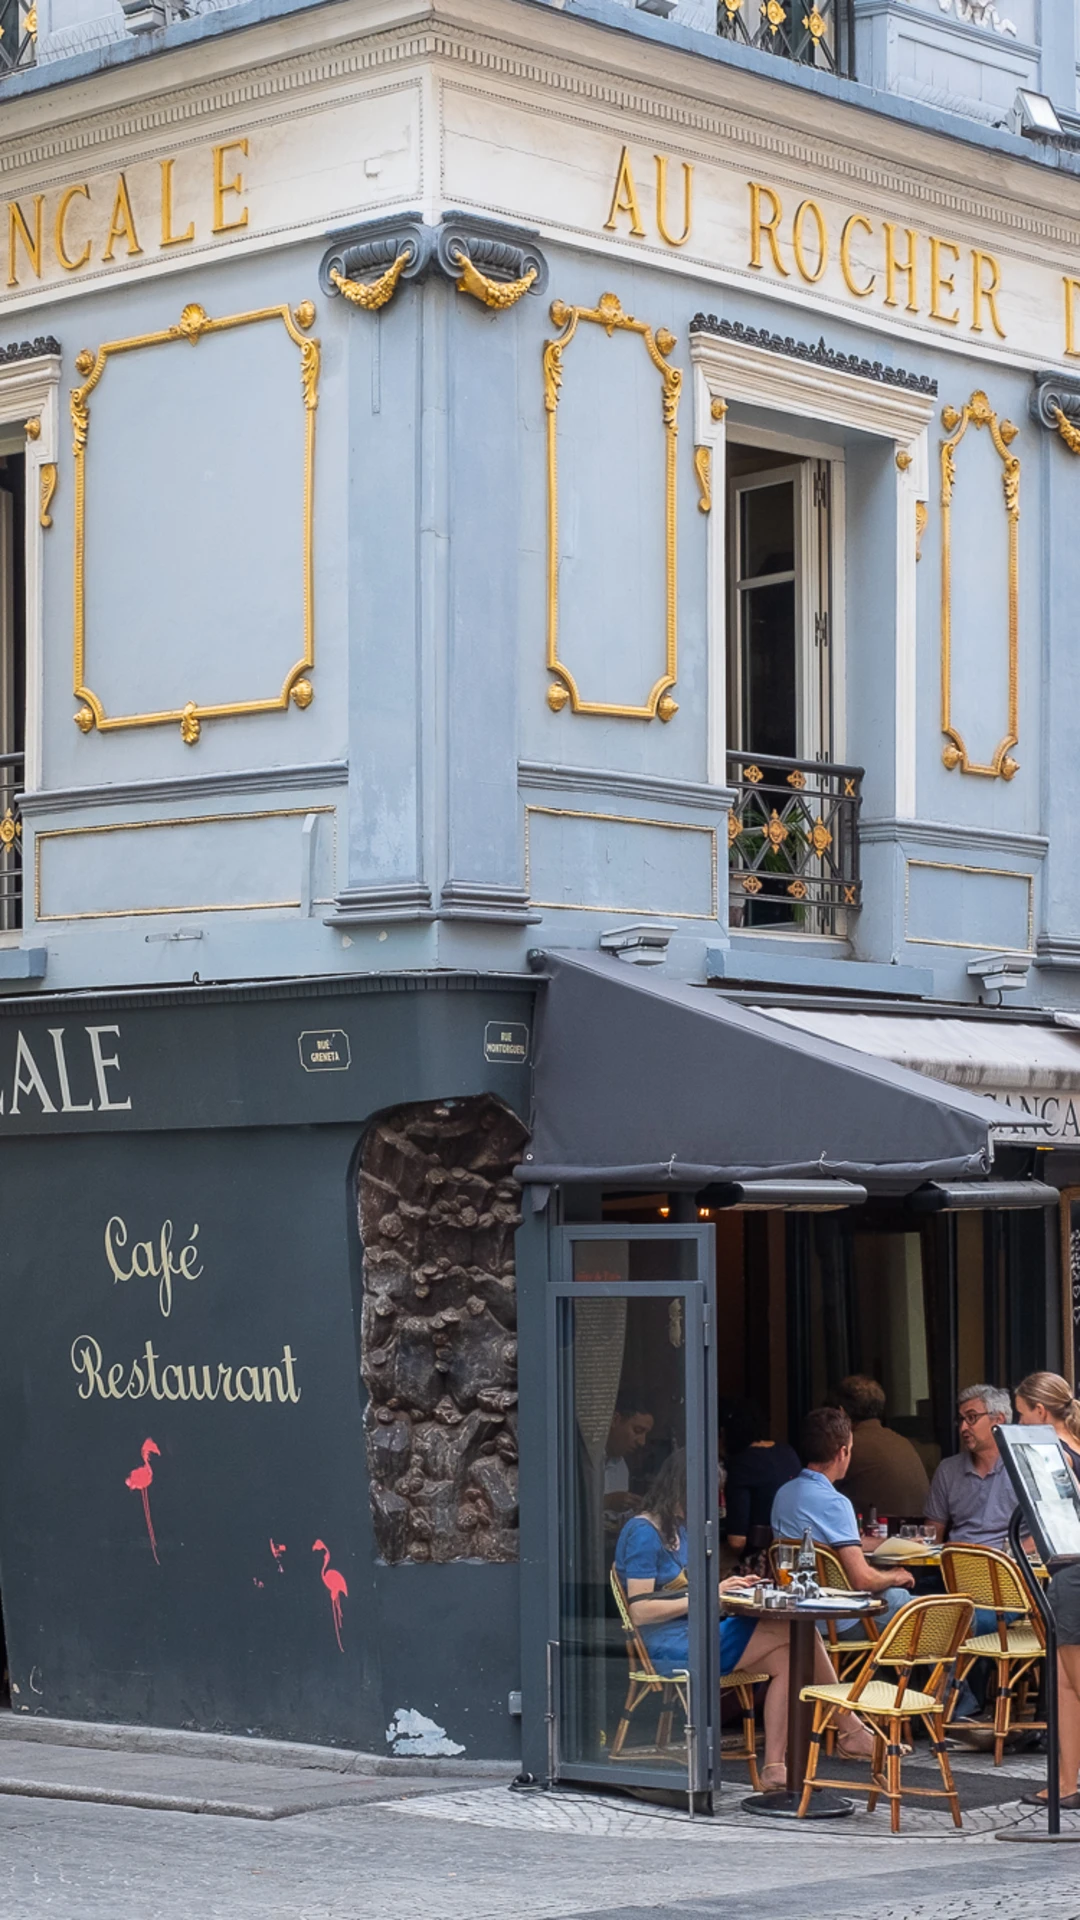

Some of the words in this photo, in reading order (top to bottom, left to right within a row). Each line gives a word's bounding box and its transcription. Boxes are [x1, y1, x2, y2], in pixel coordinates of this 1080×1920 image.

[7, 138, 249, 286] NCALE
[603, 146, 694, 246] AU
[747, 181, 1007, 338] ROCHER
[0, 1025, 132, 1115] ALE
[311, 1051, 340, 1062] GRENETA
[317, 1039, 330, 1050] RUE
[501, 1032, 512, 1042] RUE
[105, 1216, 204, 1317] Café
[71, 1335, 301, 1404] Restaurant
